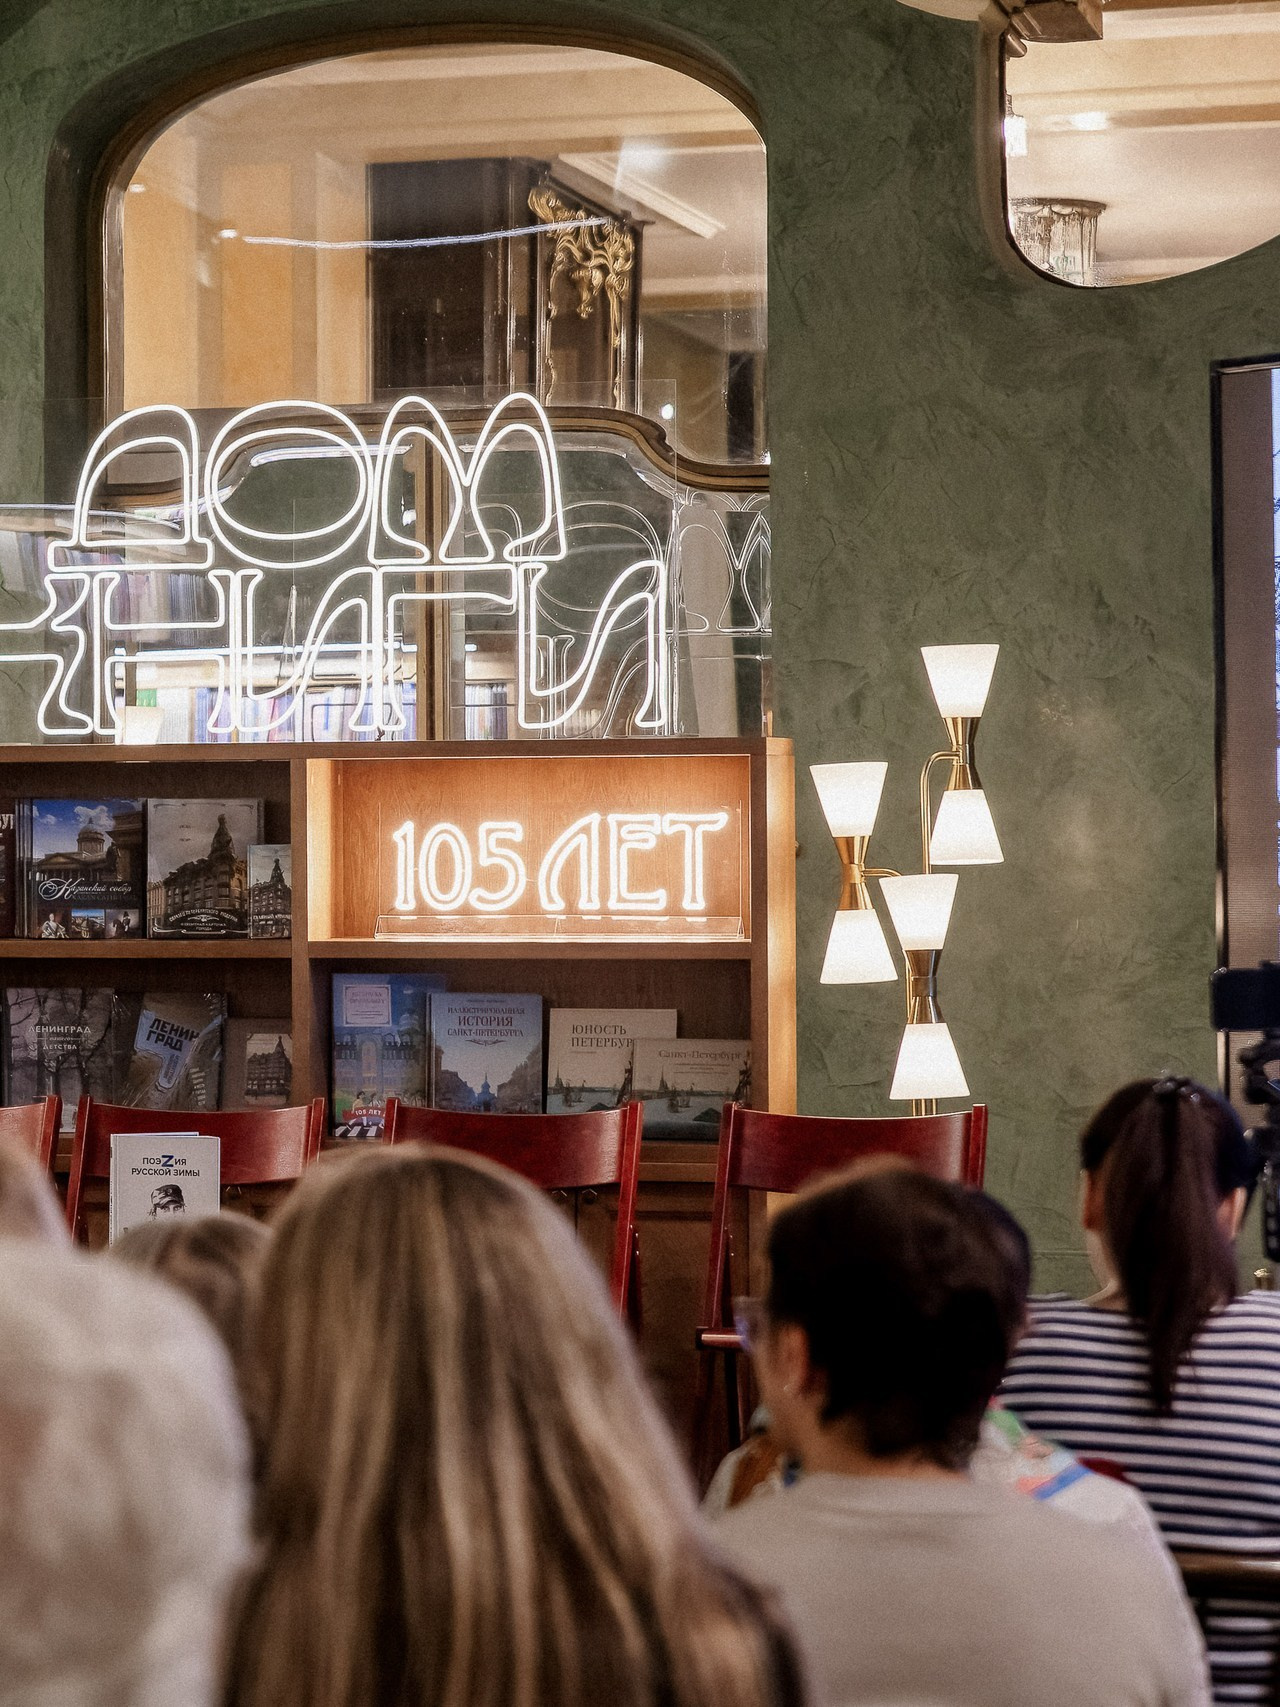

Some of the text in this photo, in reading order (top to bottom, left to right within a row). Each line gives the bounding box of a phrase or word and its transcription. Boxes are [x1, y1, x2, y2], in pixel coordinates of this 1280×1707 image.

[48, 391, 568, 570] ДОМ
[392, 812, 730, 911] 105 ЛЕТ
[108, 883, 132, 895] собор
[458, 1016, 513, 1027] ИСТОРИЯ
[28, 1025, 92, 1034] ЛЕНИНГРАД
[150, 1018, 201, 1041] ЛЕНИН
[447, 1028, 524, 1037] САНКТ-ПЕТЕРБУРГА
[571, 1024, 627, 1035] ЮНОСТЬ
[146, 1030, 183, 1052] ГРАД
[131, 1168, 200, 1177] РУССКОЙ ЗИМЫ
